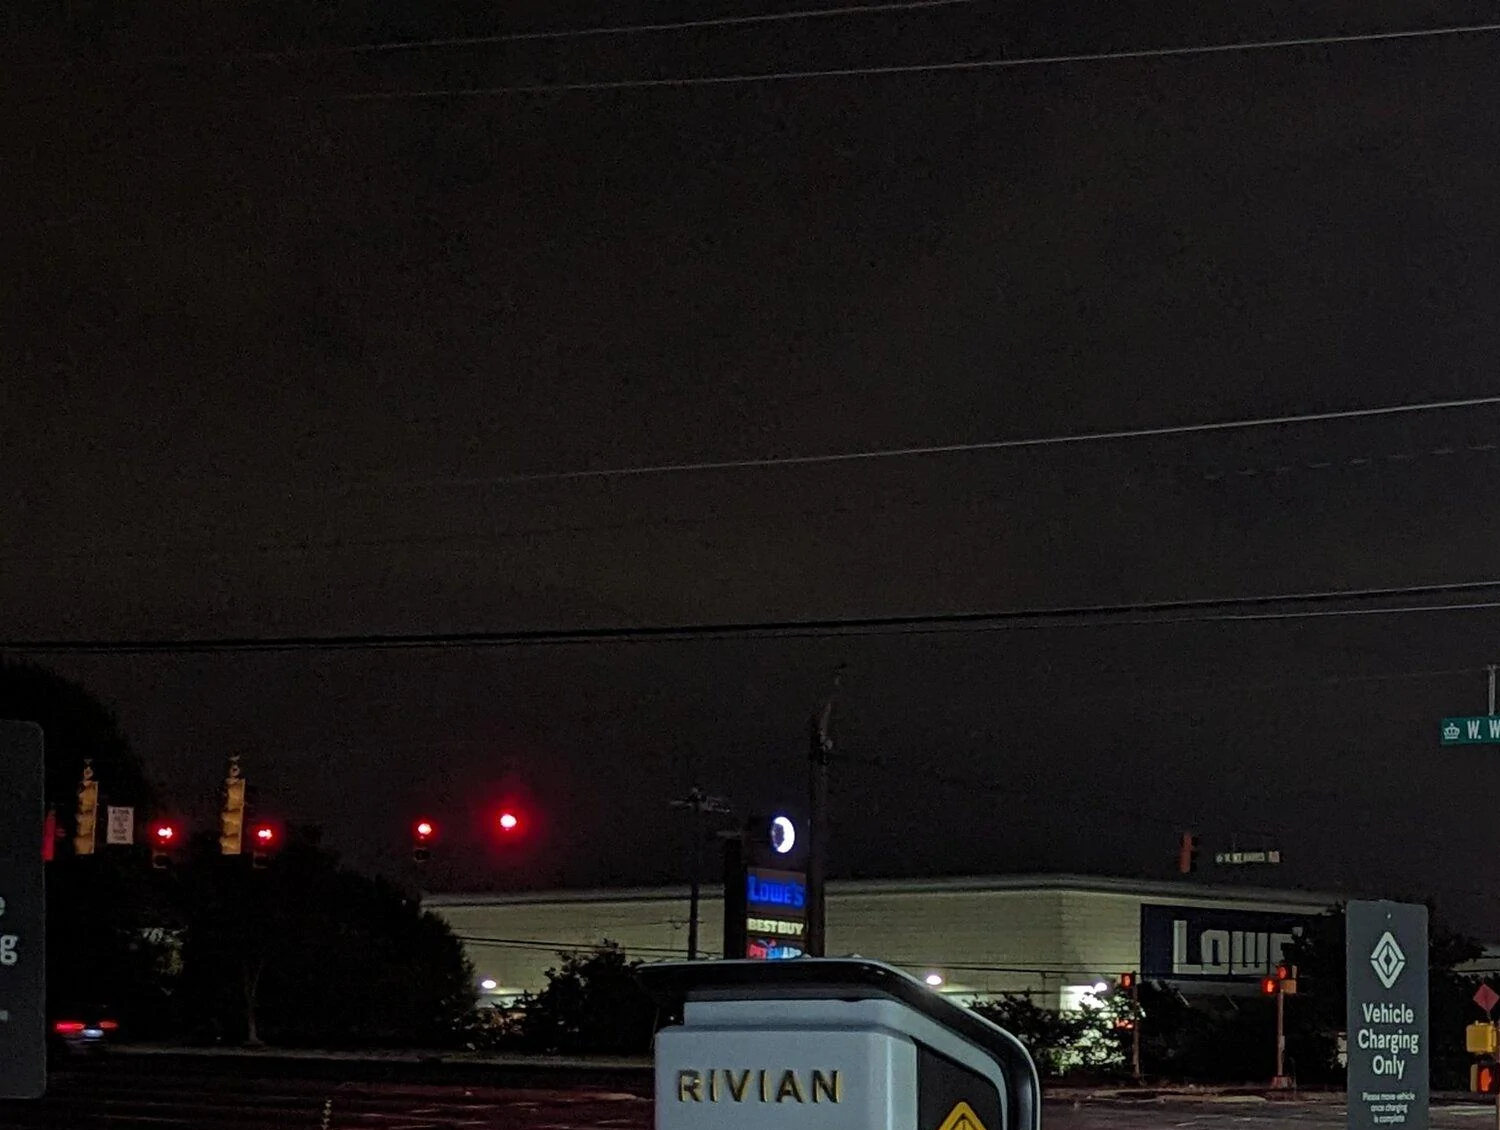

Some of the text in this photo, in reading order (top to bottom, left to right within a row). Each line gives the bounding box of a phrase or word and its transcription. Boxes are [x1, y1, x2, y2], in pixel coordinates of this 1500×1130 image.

[1467, 720, 1482, 740] W.
[747, 875, 805, 906] LOWE'S
[747, 918, 804, 935] BEST BUY
[1362, 1003, 1414, 1023] Vehicle
[1358, 1028, 1419, 1054] Charging
[1372, 1054, 1405, 1080] Only
[677, 1068, 841, 1105] RIVIAN
